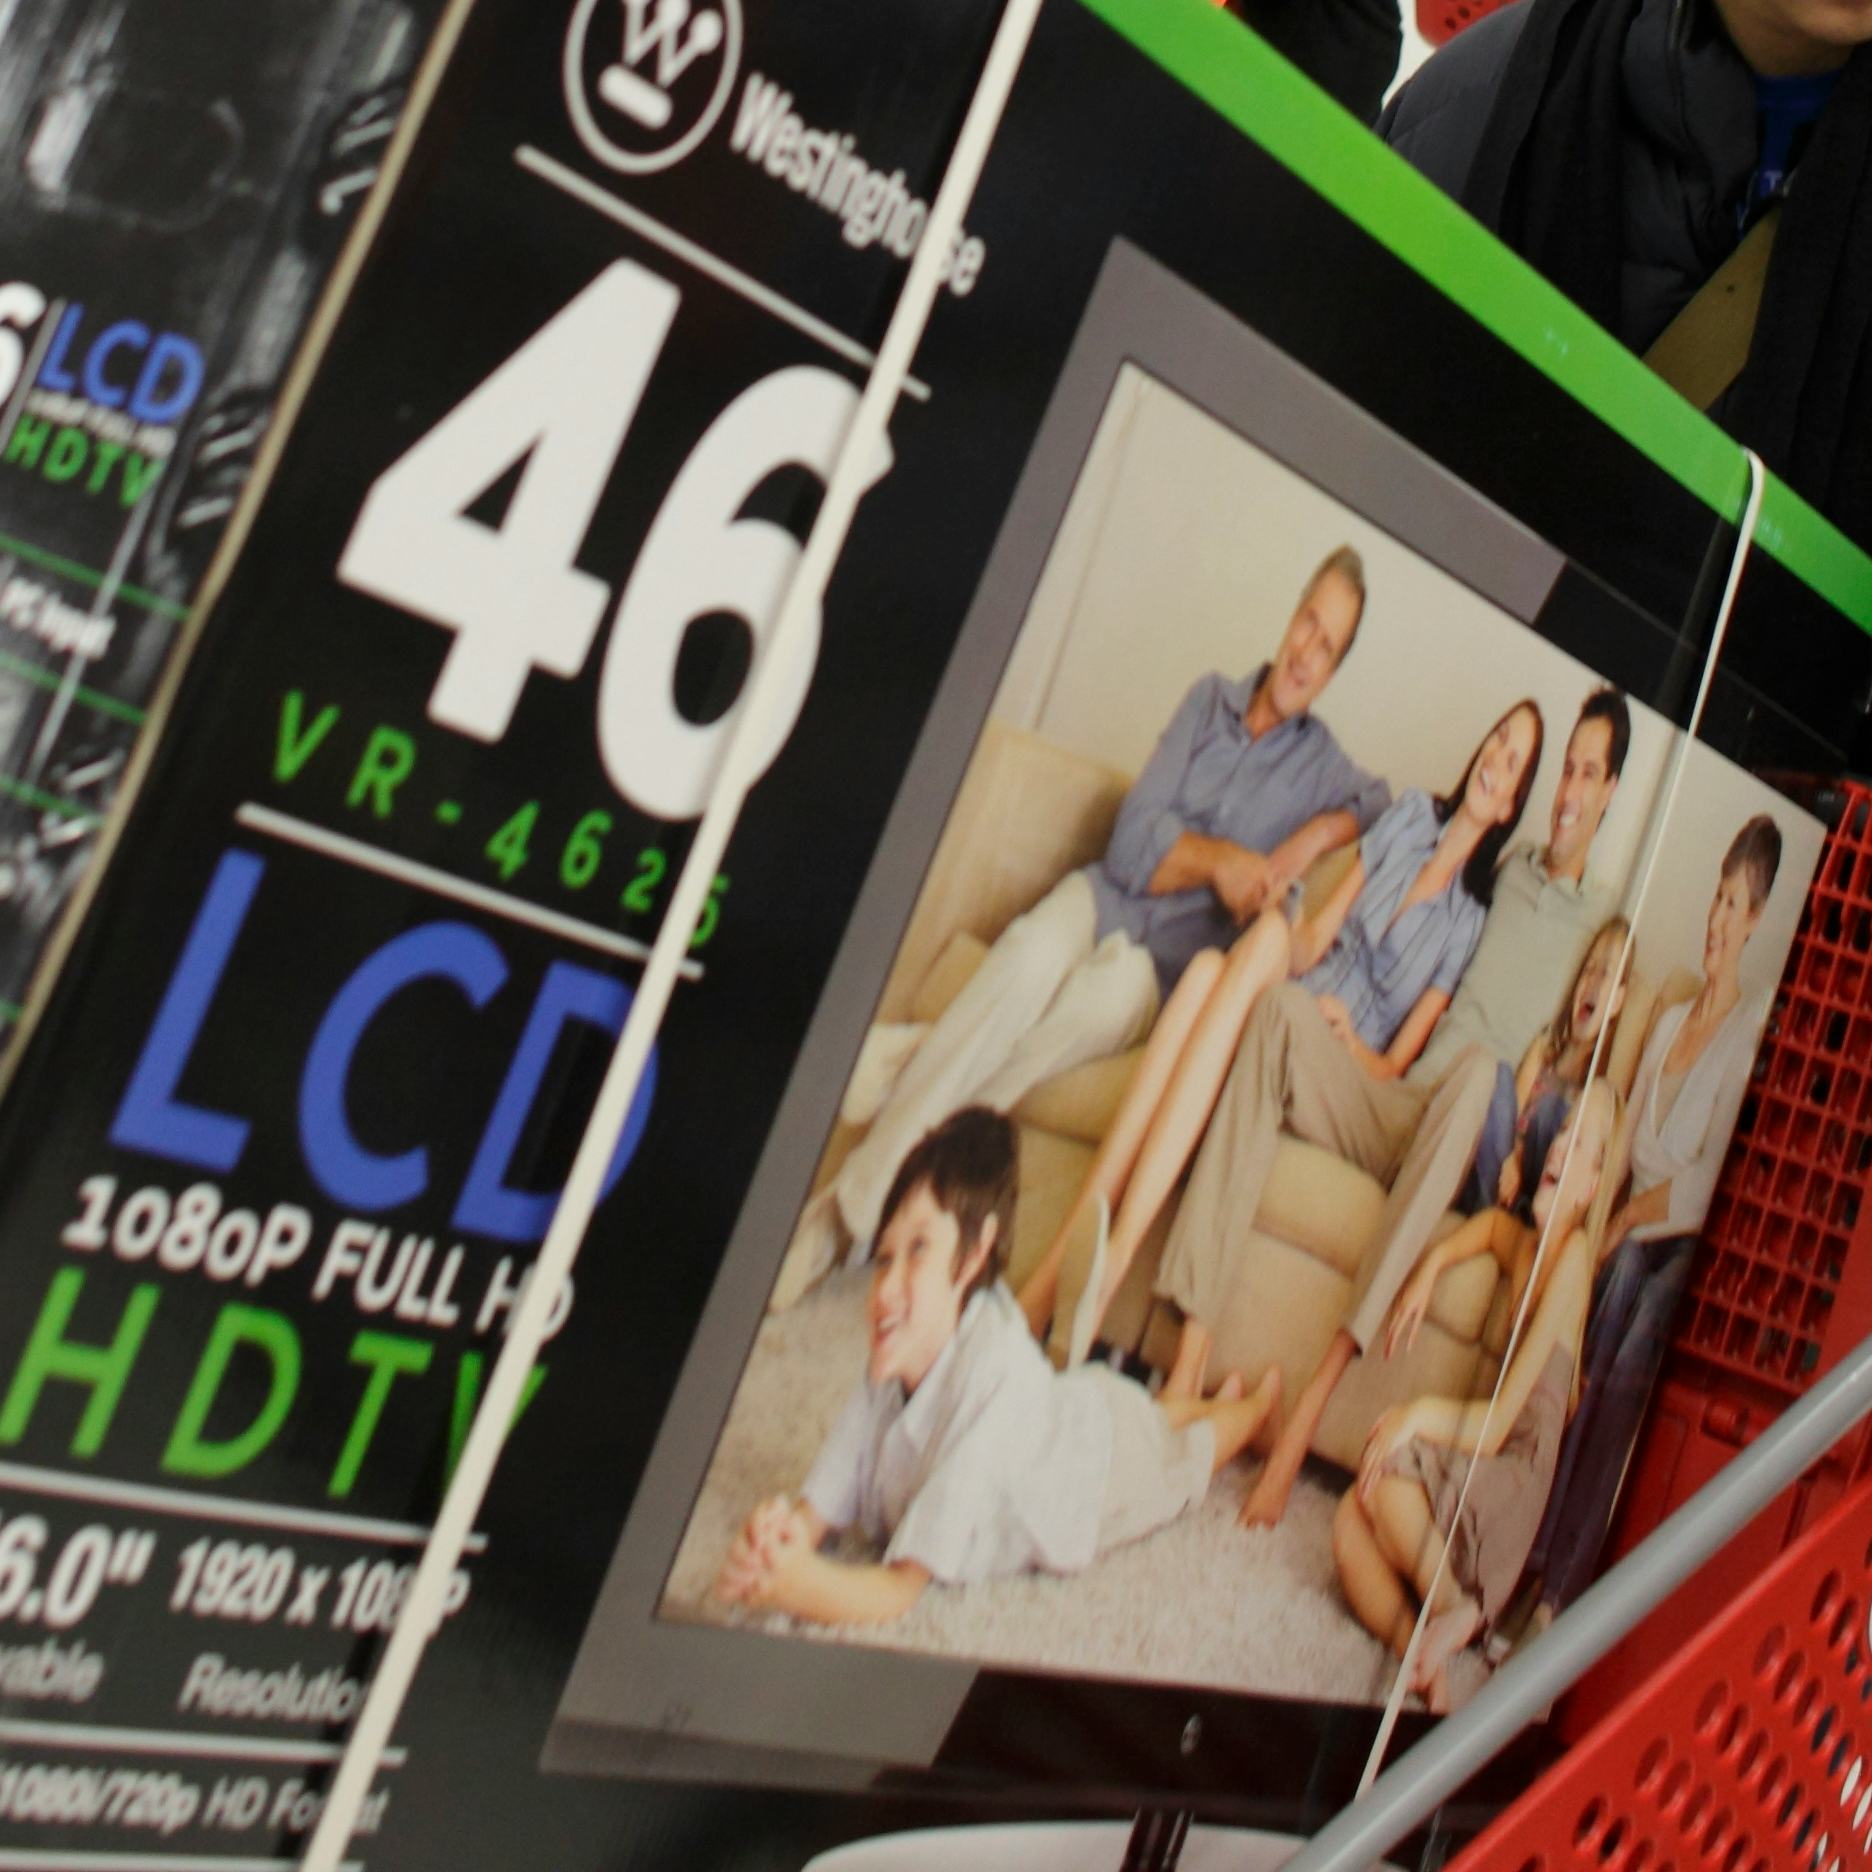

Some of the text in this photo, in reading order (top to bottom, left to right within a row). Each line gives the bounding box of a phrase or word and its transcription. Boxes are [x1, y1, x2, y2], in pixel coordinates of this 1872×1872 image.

[730, 71, 987, 297] Westinghose
[35, 301, 205, 426] LCD
[2, 412, 168, 509] HDTV
[336, 256, 897, 824] 46
[271, 688, 731, 948] VR-4625
[108, 845, 662, 1244] LCD
[59, 1174, 314, 1287] 1080P
[311, 1217, 466, 1327] FULL
[168, 1534, 297, 1624] 1920
[285, 1564, 331, 1626] x
[176, 1650, 371, 1724] Resolutio
[203, 1775, 270, 1830] HD
